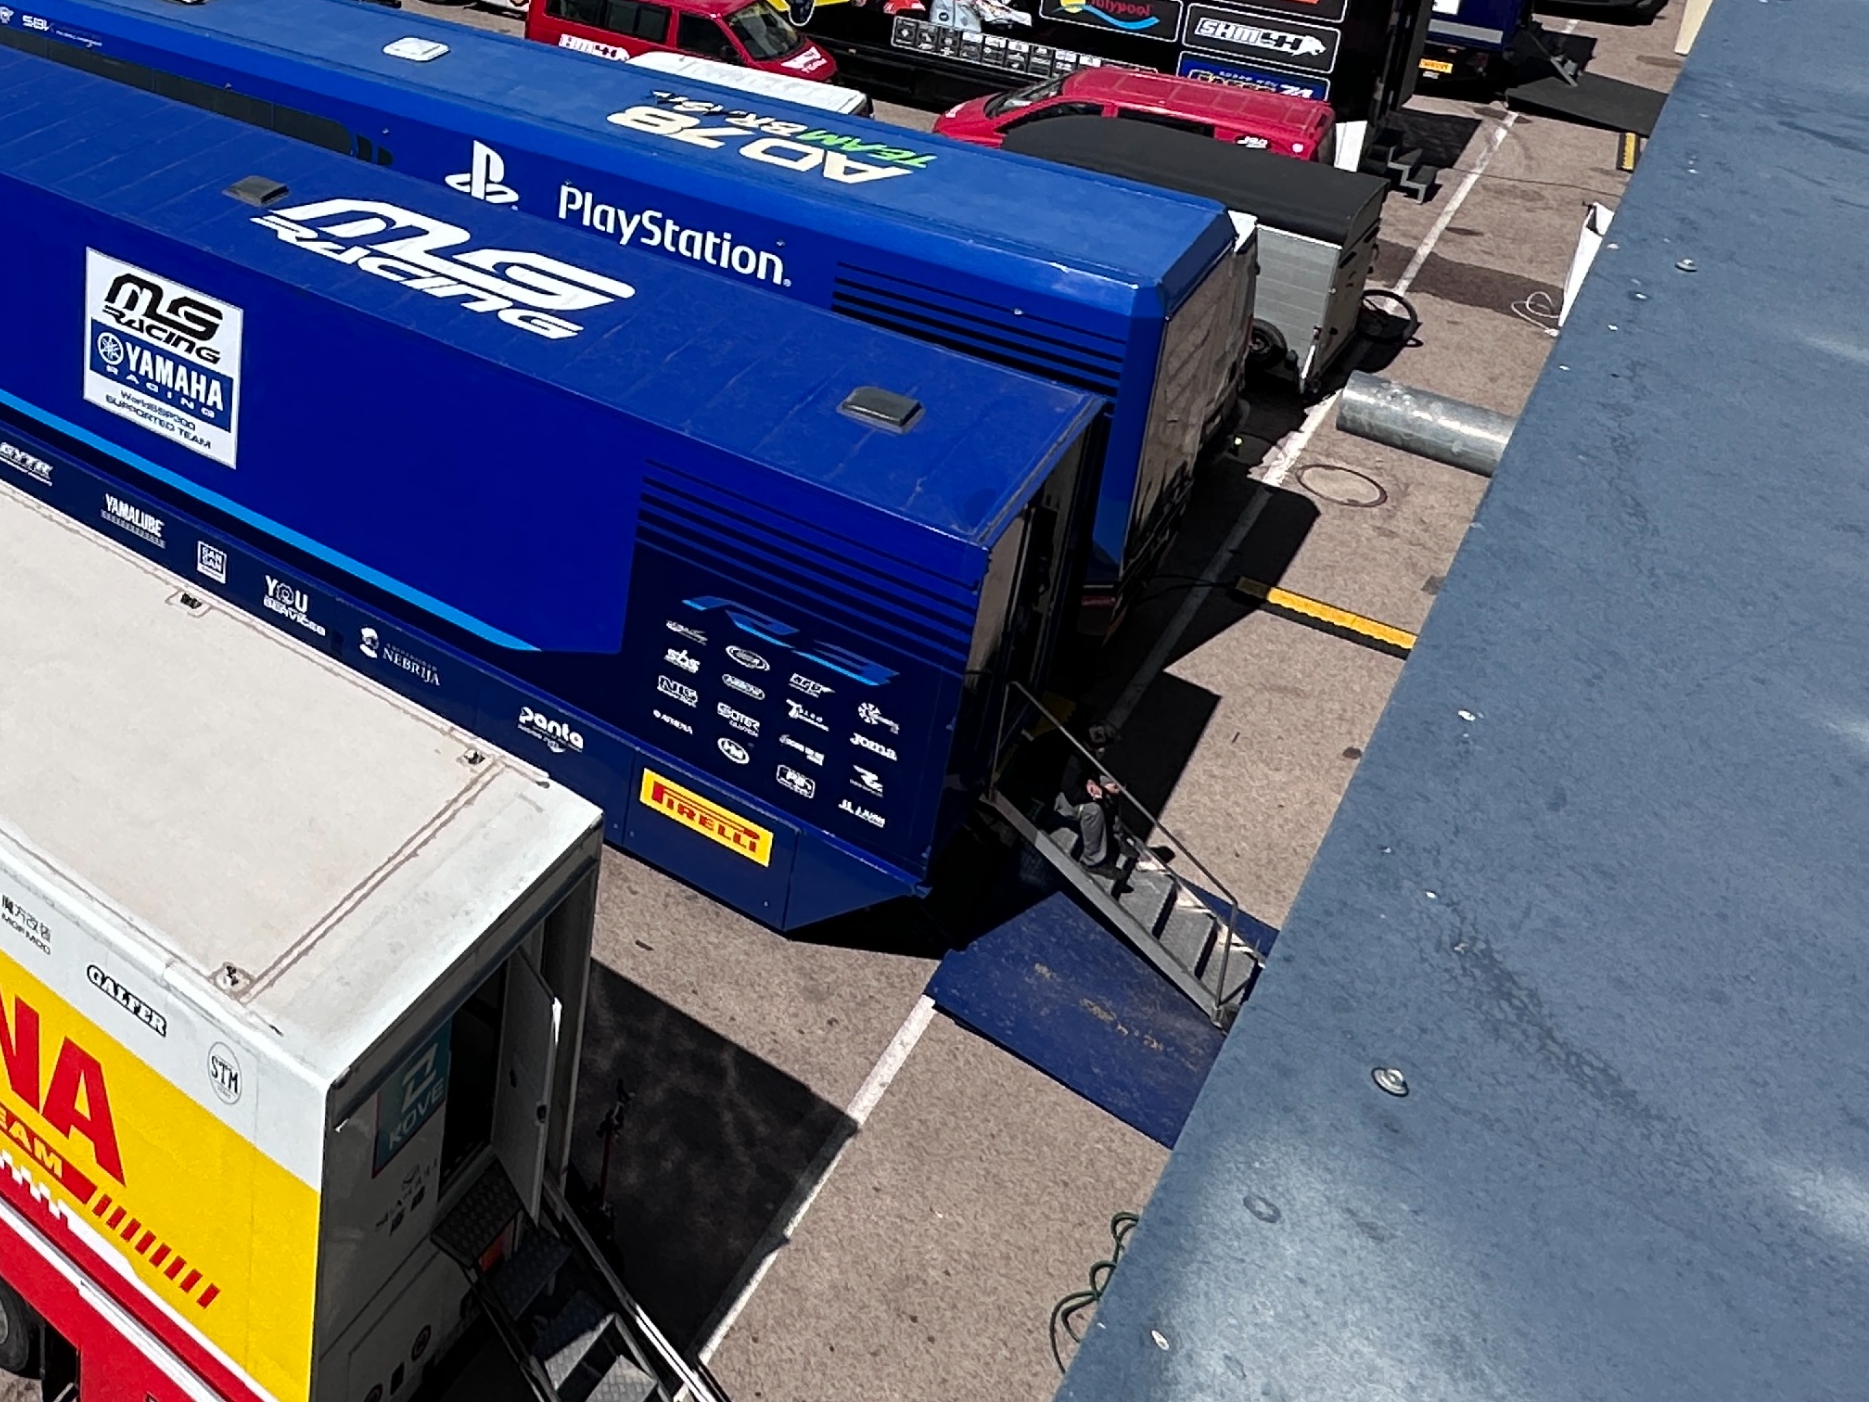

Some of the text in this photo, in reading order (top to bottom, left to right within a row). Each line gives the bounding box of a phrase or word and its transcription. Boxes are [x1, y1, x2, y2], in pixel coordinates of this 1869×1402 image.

[558, 184, 785, 285] PlayStation
[250, 215, 586, 341] RACING
[103, 304, 221, 365] RACING
[106, 365, 216, 419] RACING
[126, 341, 224, 411] YAMAHA
[105, 394, 211, 449] SUPPORTED TEAM
[105, 493, 164, 537] YAMALUBE
[202, 547, 223, 564] SAN
[382, 647, 440, 686] NEBRIJA
[651, 780, 761, 853] PIRELLI
[87, 964, 167, 1037] GALFER
[211, 1055, 239, 1094] STM
[389, 1077, 445, 1151] KOVE
